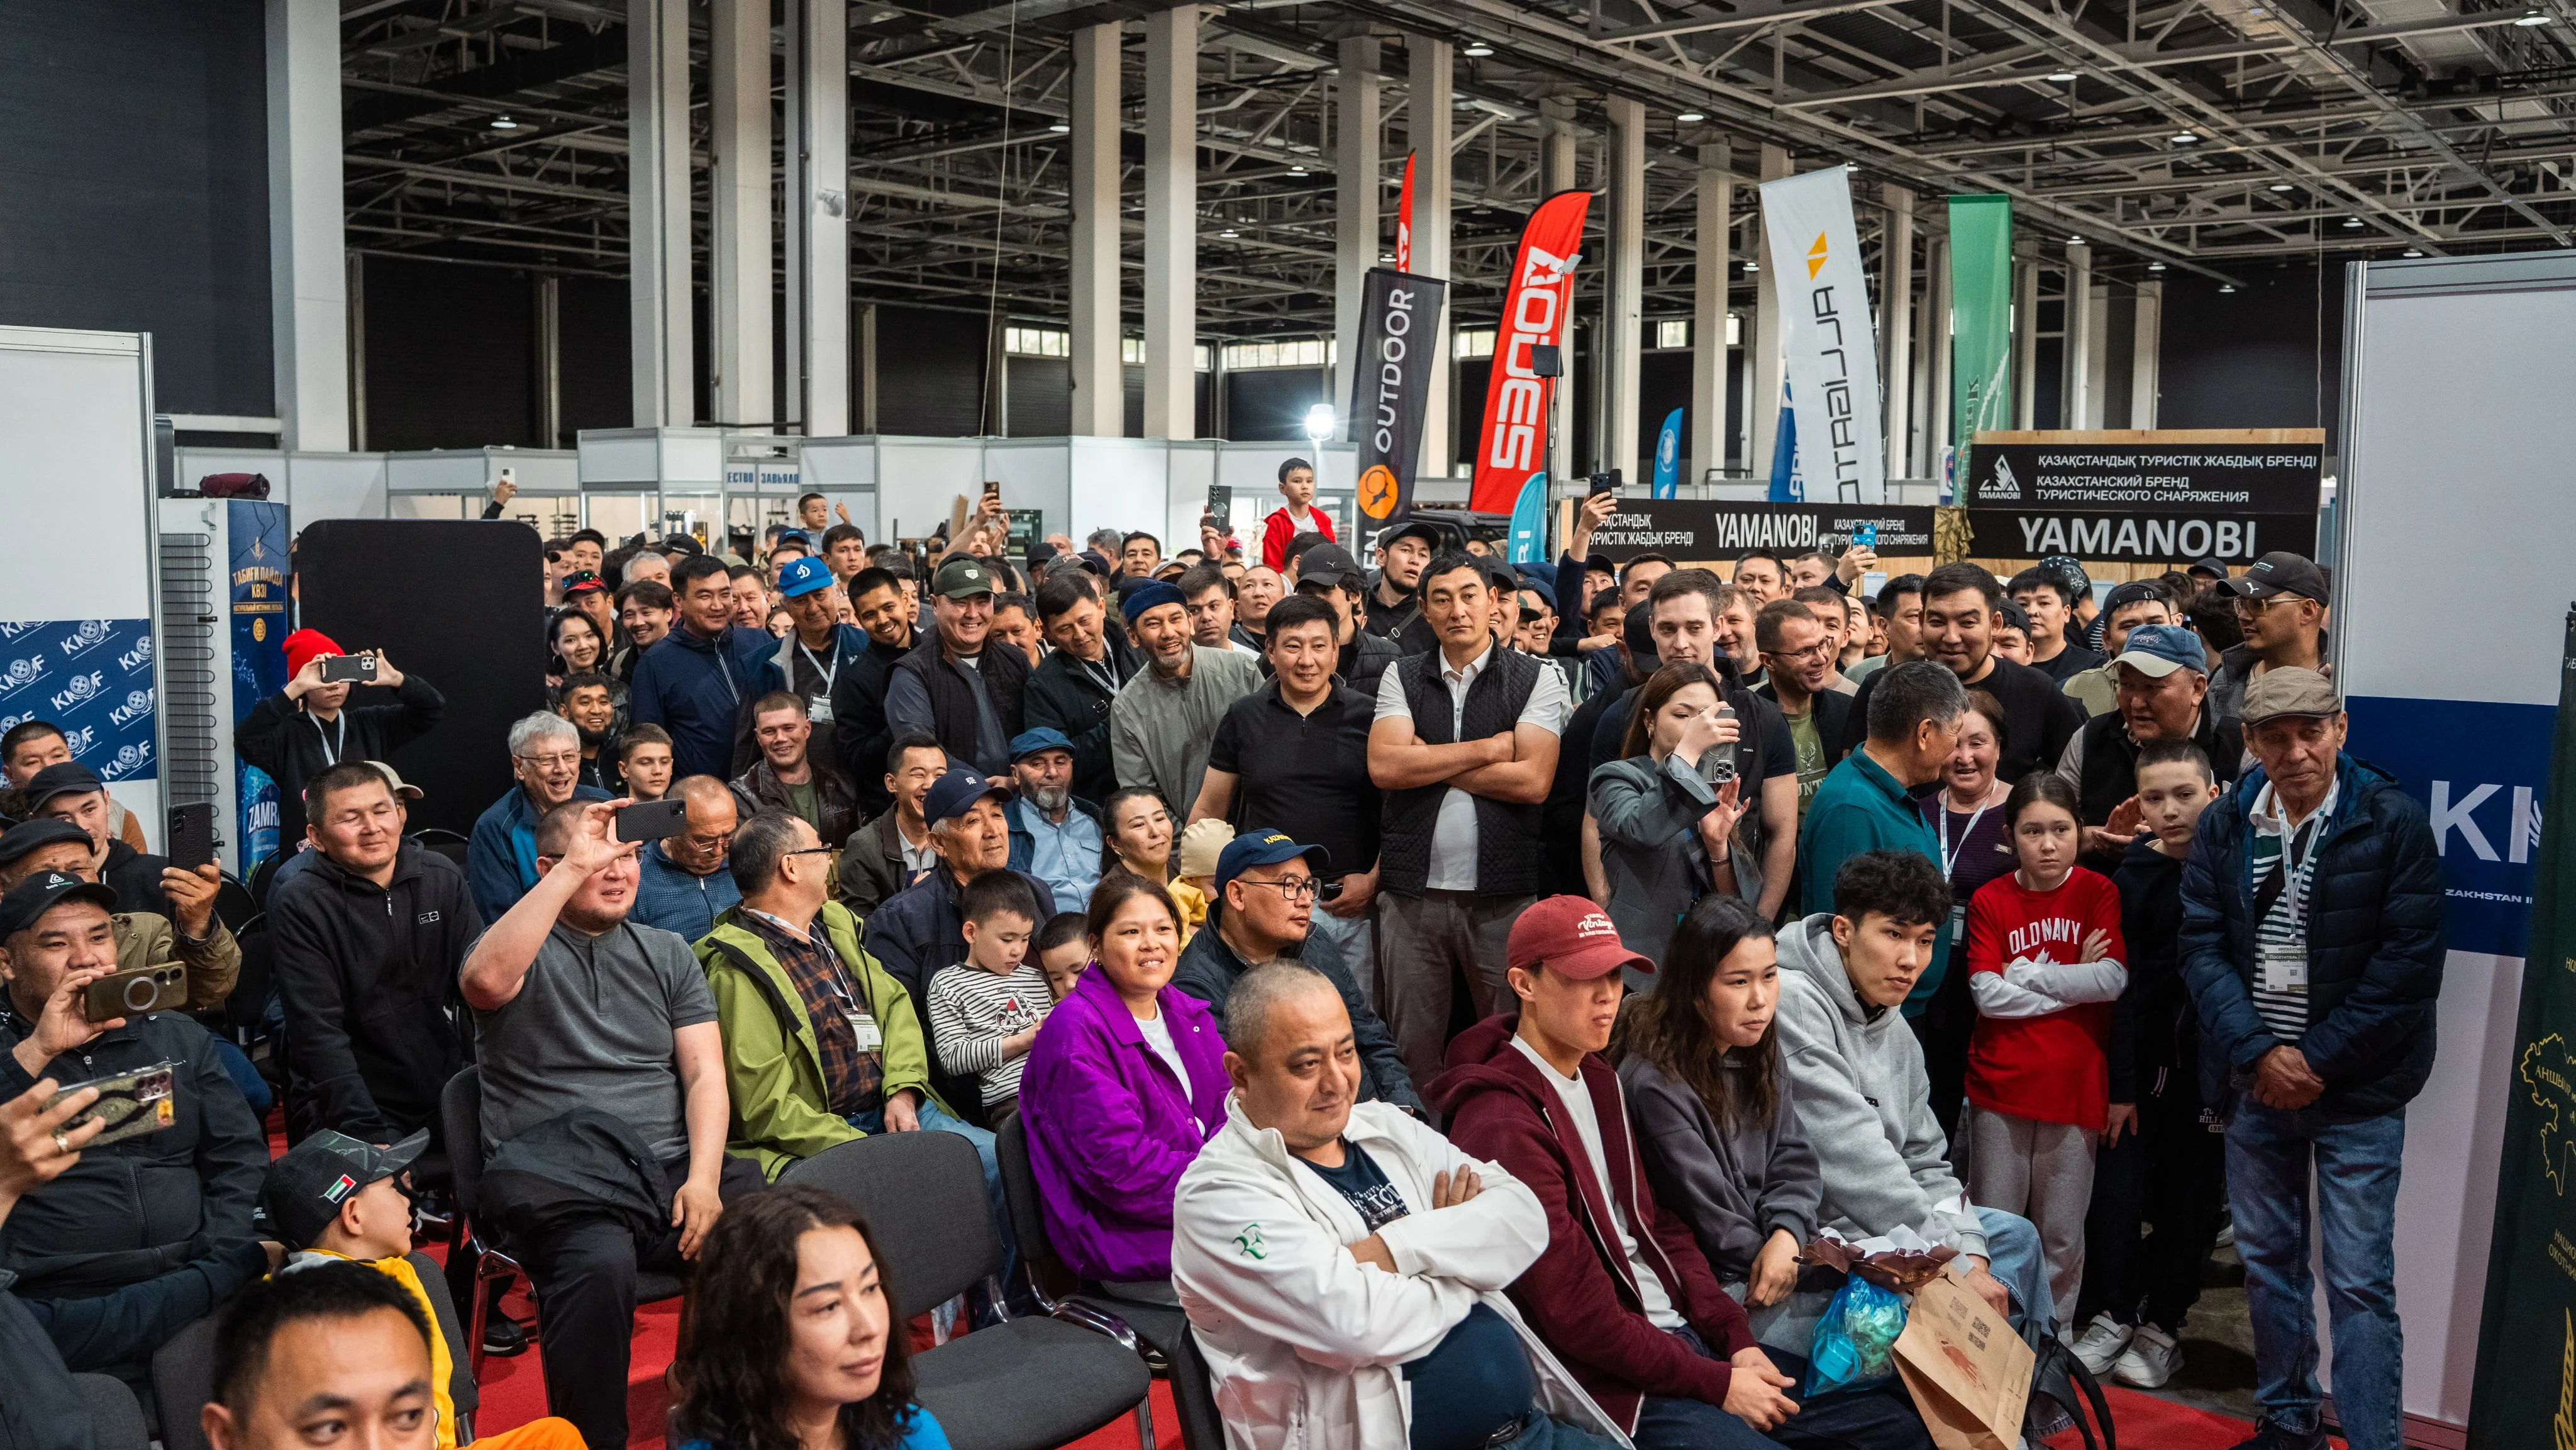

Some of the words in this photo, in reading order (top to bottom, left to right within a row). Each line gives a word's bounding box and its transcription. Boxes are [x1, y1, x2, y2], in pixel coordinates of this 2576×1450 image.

[1375, 288, 1414, 453] OUTDOOR
[2038, 455, 2137, 468] ҚАЗАҚСТАНДЫҚ
[2139, 455, 2202, 466] ТУРИСТІК
[2204, 455, 2263, 469] ЖАБДЫҚ
[2266, 455, 2317, 469] БРЕНДІ
[2037, 474, 2142, 487] КАЗАХСТАНСКИЙ
[2145, 477, 2189, 489] БРЕНД
[1978, 491, 2021, 499] YAMANOBI
[2036, 489, 2151, 501] ТУРИСТИЧЕСКОГО
[2154, 491, 2249, 502] СНАРЯЖЕНИЯ
[1715, 513, 1818, 549] YAMANOBI
[1886, 520, 1905, 532] БРЕНД
[1590, 532, 1626, 545] УРИСТІК
[1628, 532, 1663, 547] ЖАБДЫҚ
[1665, 532, 1693, 547] БРЕНДІ
[1890, 534, 1928, 545] СНАРЯЖЕНИЯ
[2018, 517, 2255, 558] YAMANOBI
[2445, 889, 2521, 903] ZAKHSTAN
[2009, 922, 2040, 955] OLD
[2041, 918, 2081, 945] NAVY
